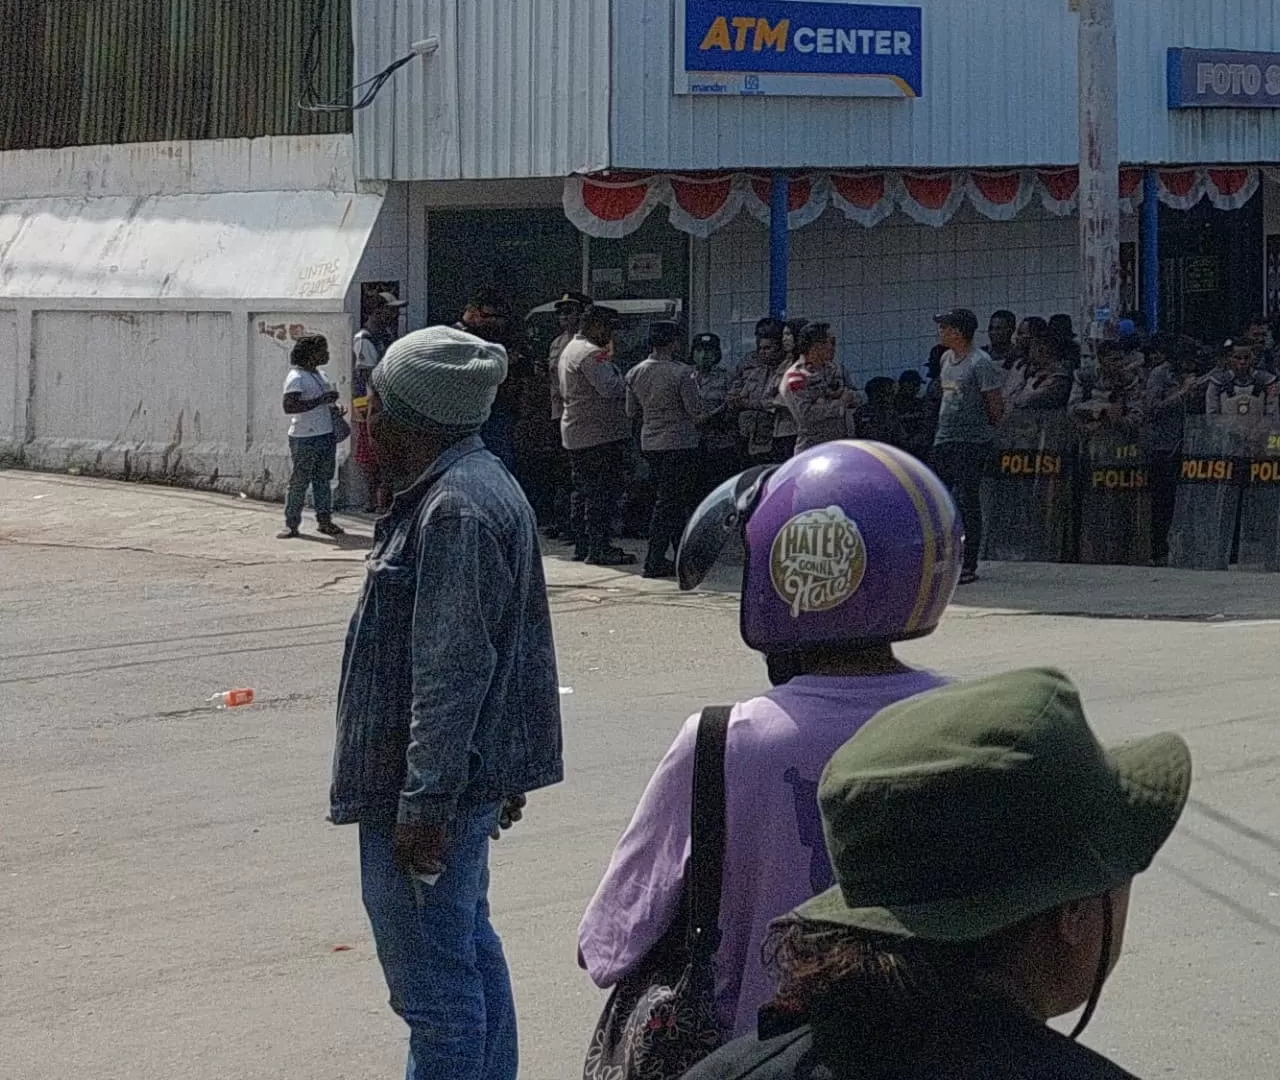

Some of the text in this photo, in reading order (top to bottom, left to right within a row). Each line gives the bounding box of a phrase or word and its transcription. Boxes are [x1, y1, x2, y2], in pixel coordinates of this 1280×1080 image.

[700, 16, 913, 56] ATM CENTER
[1196, 62, 1261, 96] FOTO
[1001, 454, 1061, 475] POLISI
[1180, 459, 1234, 480] POLISI
[1092, 468, 1149, 488] POLISI
[780, 522, 856, 560] HATERS
[798, 560, 833, 577] GONNA
